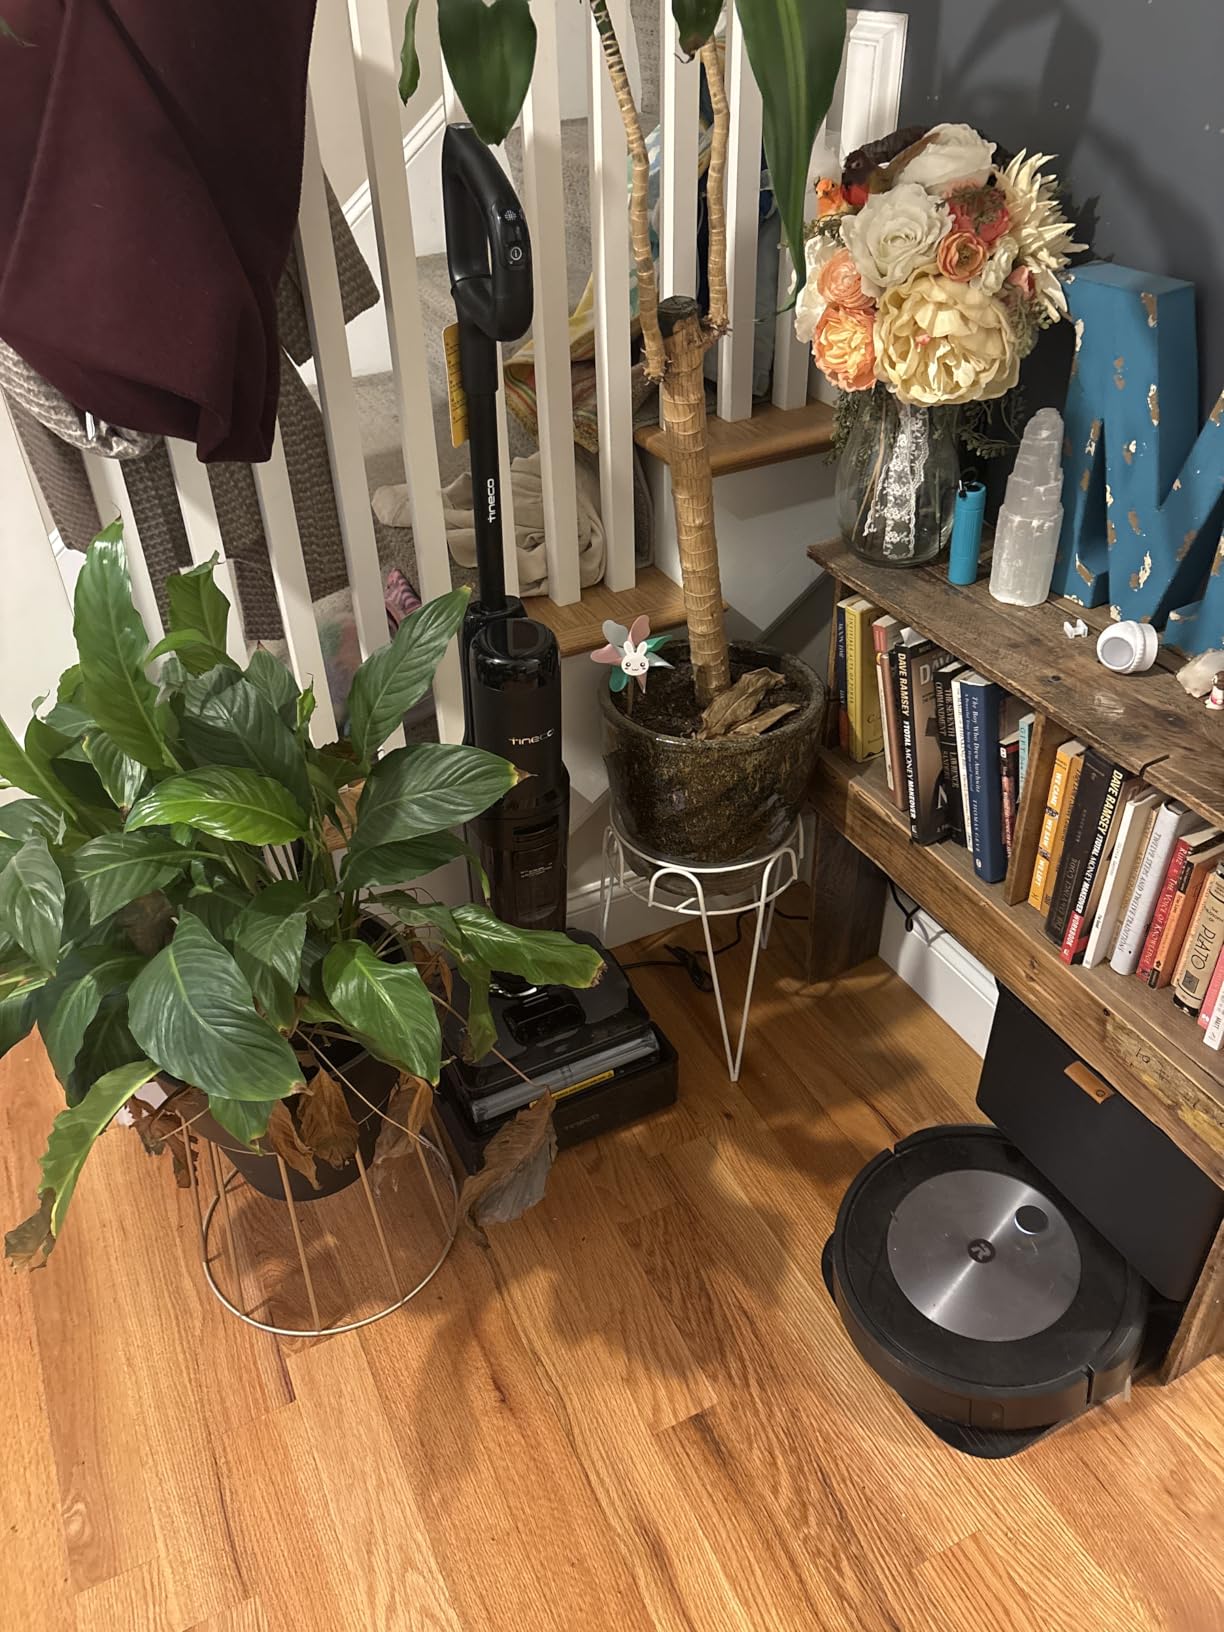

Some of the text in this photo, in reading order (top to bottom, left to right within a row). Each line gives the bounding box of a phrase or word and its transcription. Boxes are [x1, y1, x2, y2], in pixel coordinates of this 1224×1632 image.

[897, 652, 908, 677] DAVE
[899, 679, 910, 717] RAMSEY
[935, 681, 947, 737] COMMANDMENT
[971, 696, 979, 709] The
[944, 688, 956, 737] THE SEVENTH
[903, 725, 912, 747] TOTAL
[972, 725, 980, 741] Who
[905, 747, 914, 780] MONEY
[1054, 772, 1063, 784] WE
[1108, 768, 1124, 797] DAVE
[908, 780, 917, 819] MAKEOVER
[1050, 784, 1060, 807] CAME
[1046, 818, 1053, 830] WE
[1098, 793, 1117, 836] RAMSEY
[1043, 830, 1051, 848] SAW
[1091, 837, 1103, 857] TOTAL
[1150, 832, 1162, 858] TWELVE
[1142, 857, 1154, 878] STEPS
[1175, 847, 1188, 866] RUIZ
[1035, 869, 1044, 887] LEFT
[1067, 857, 1078, 880] CODE
[1085, 855, 1098, 882] MONEY
[1138, 876, 1147, 892] AND
[1168, 878, 1178, 892] THE
[1075, 880, 1091, 914] MAKEOVER
[1130, 891, 1142, 915] TWELVE
[1161, 893, 1173, 914] VOICE
[1158, 912, 1165, 922] OF
[1066, 914, 1081, 948] WORKBOOK
[1118, 914, 1134, 952] TRADITIONS
[1146, 922, 1163, 965] KNOWLEDGE
[1190, 924, 1217, 970] PLATO
